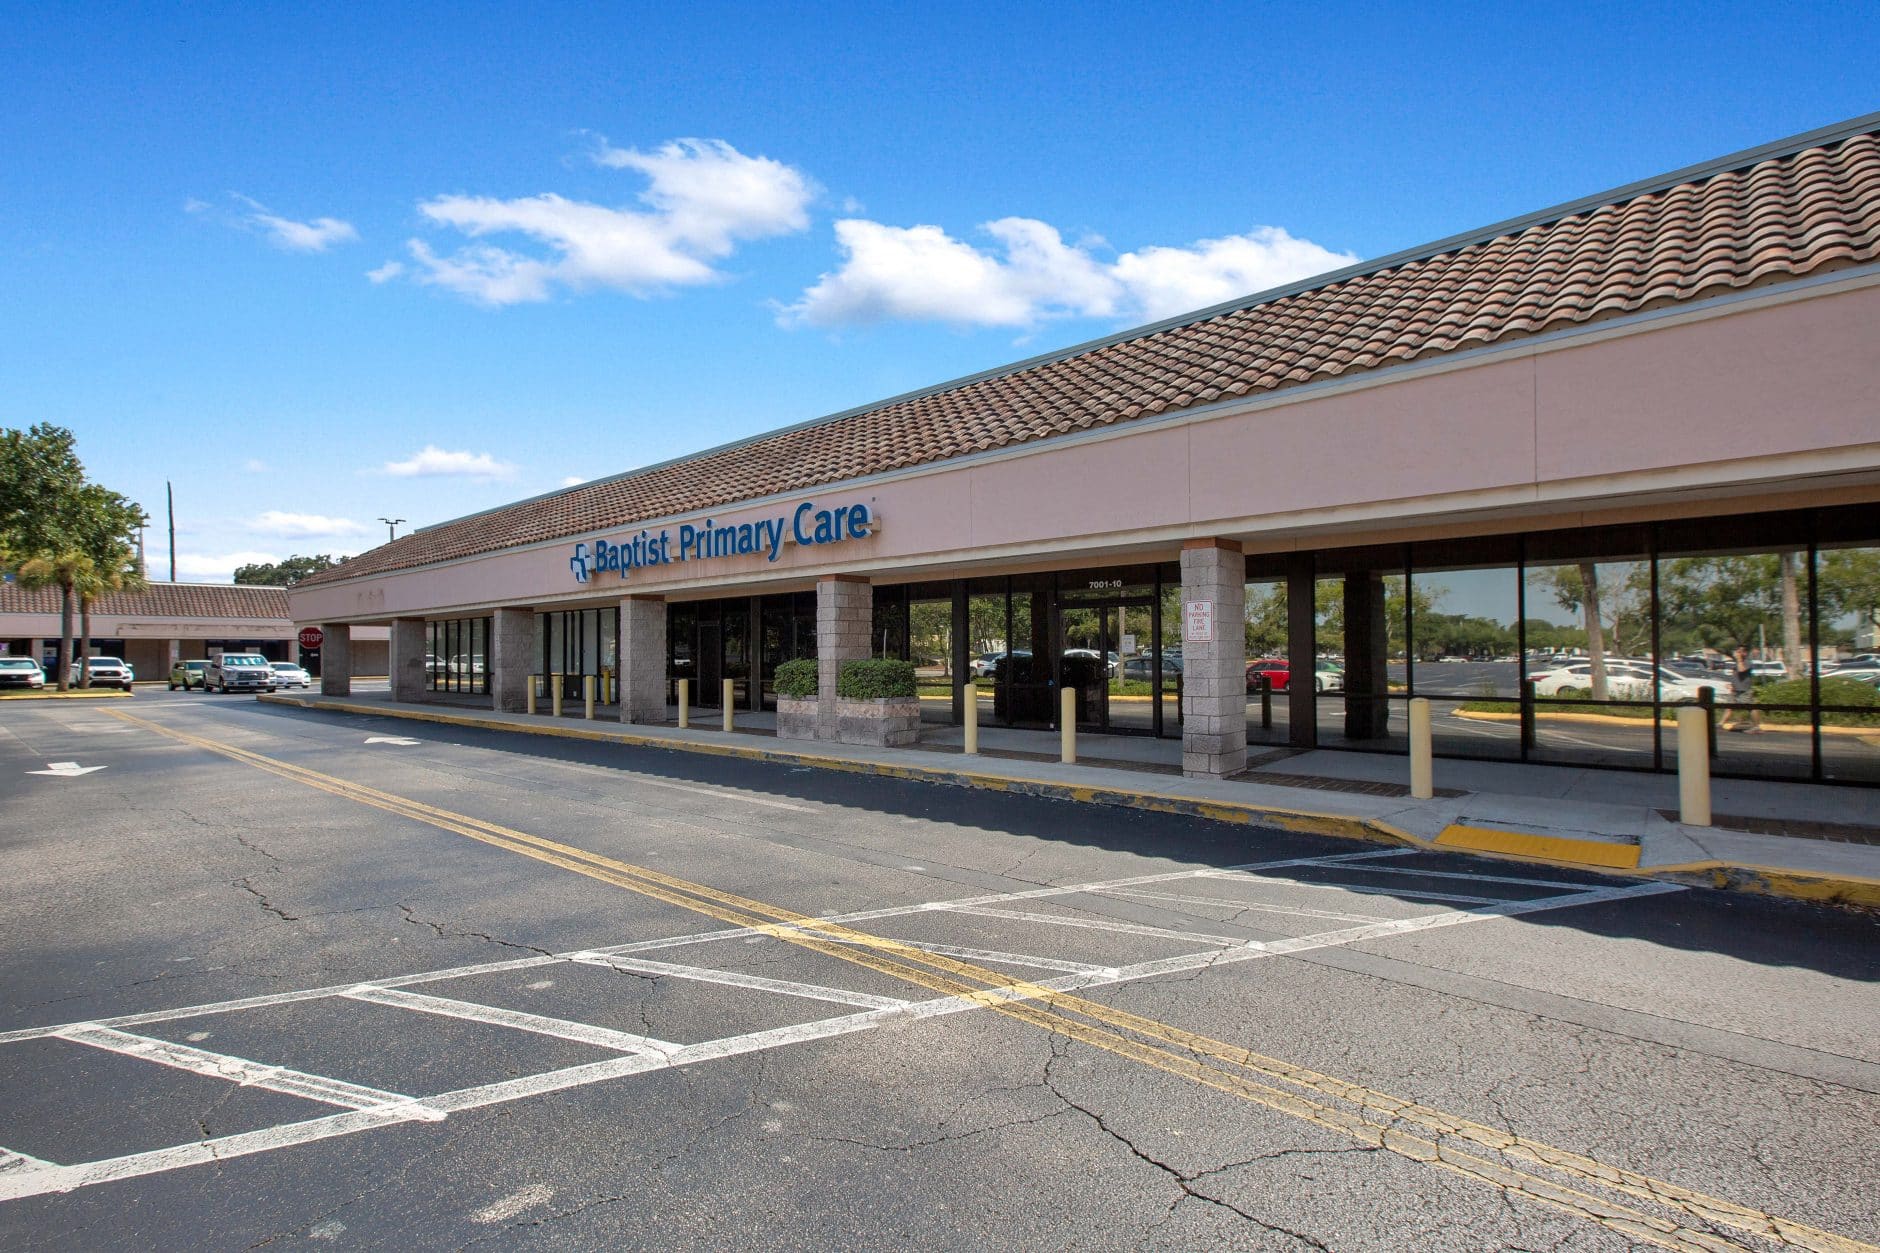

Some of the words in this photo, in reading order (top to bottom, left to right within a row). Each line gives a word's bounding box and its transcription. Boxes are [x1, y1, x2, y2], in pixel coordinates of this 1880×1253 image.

[595, 529, 671, 578] Baptist
[680, 518, 785, 563] Primary
[793, 502, 873, 546] Care
[1089, 580, 1122, 589] 7001-10
[1194, 603, 1204, 611] NO
[300, 633, 322, 642] STOP
